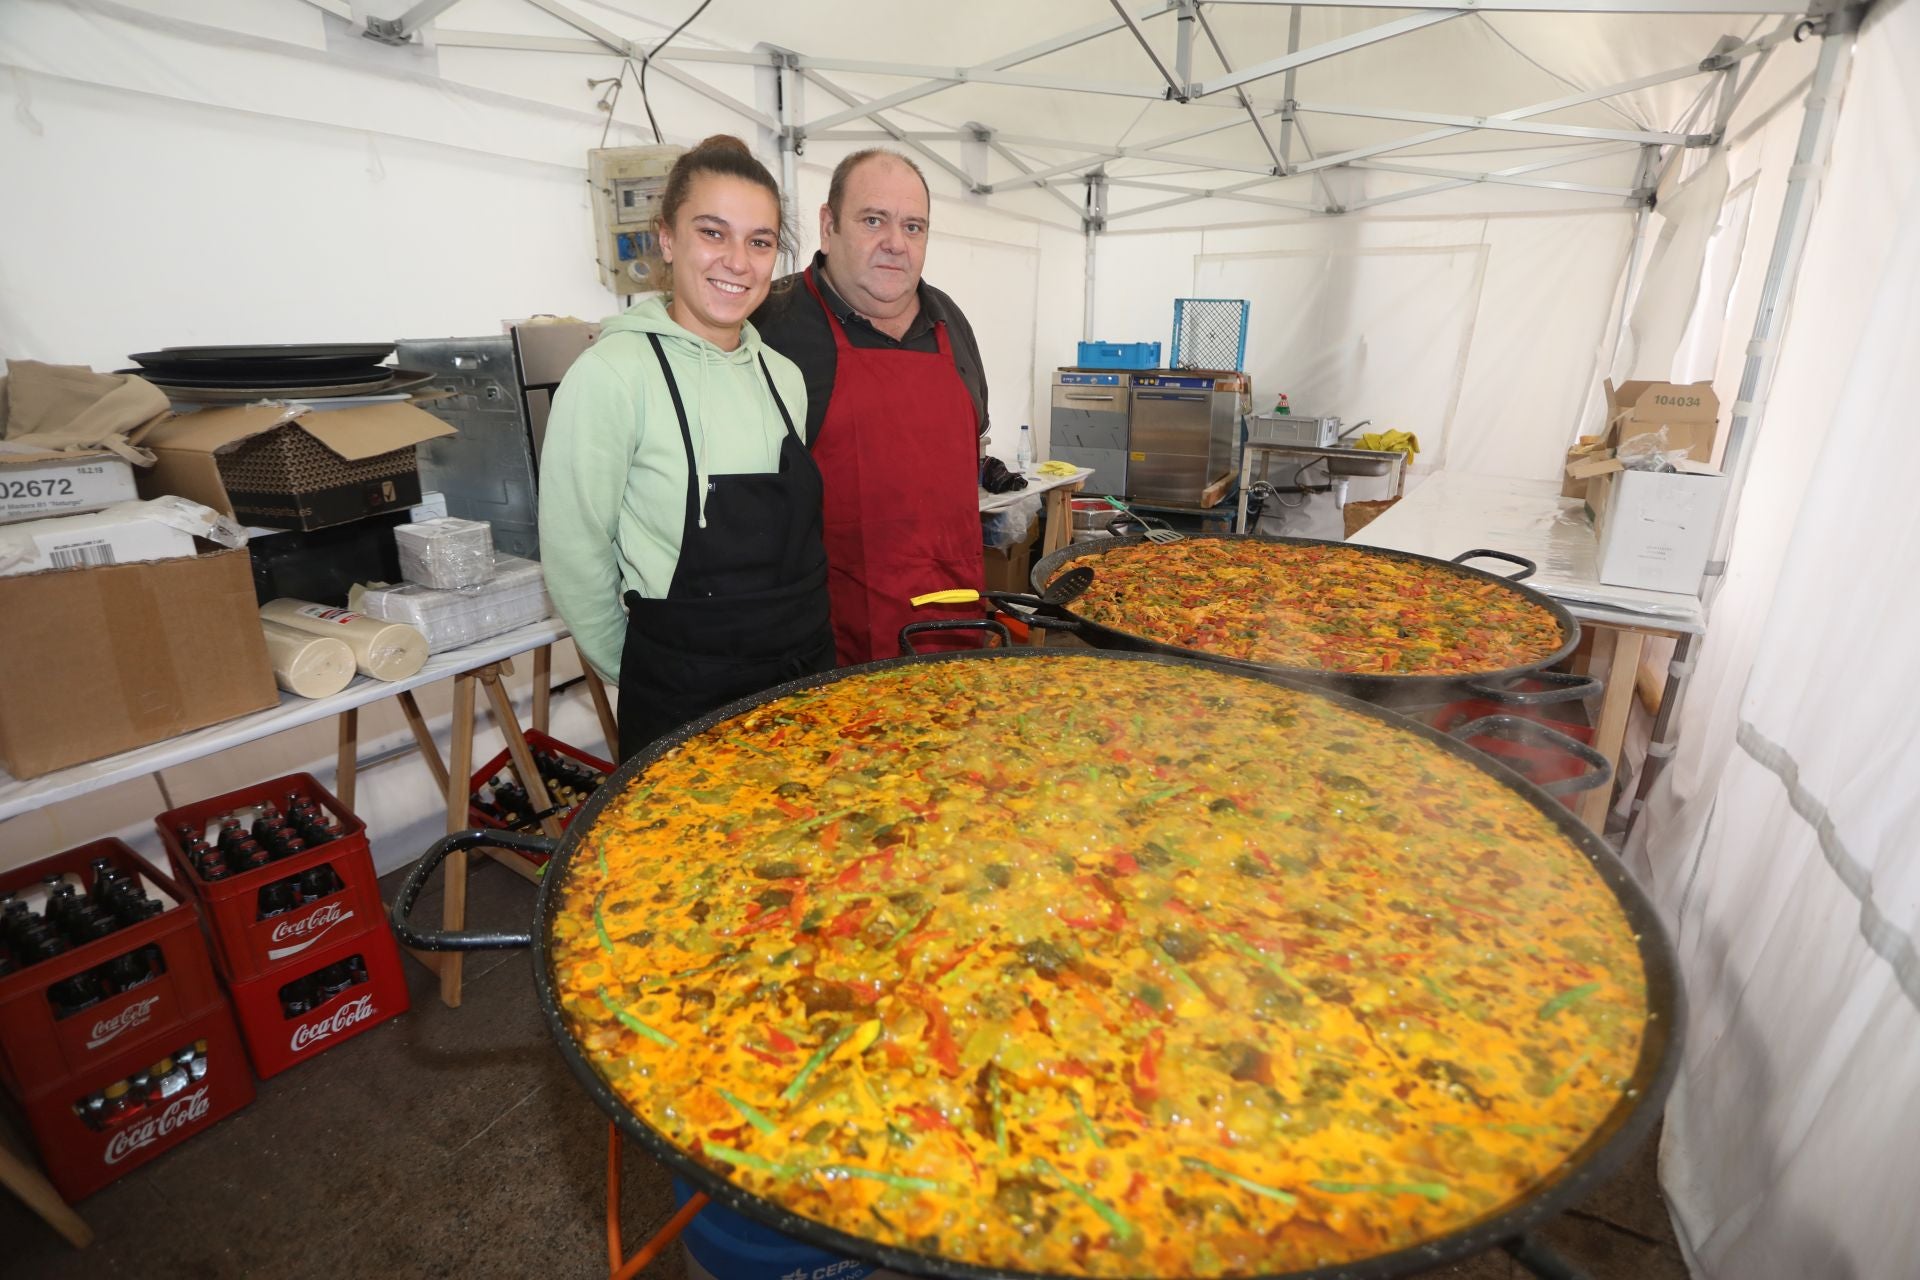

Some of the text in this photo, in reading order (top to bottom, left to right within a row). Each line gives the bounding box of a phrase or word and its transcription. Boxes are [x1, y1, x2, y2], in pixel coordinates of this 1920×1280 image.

[1655, 394, 1700, 407] 104034
[271, 901, 345, 942] Coca-Cola
[91, 998, 154, 1040] Coca-Cola
[290, 992, 373, 1052] Coca-Cola
[103, 1084, 211, 1164] Coca-Cola
